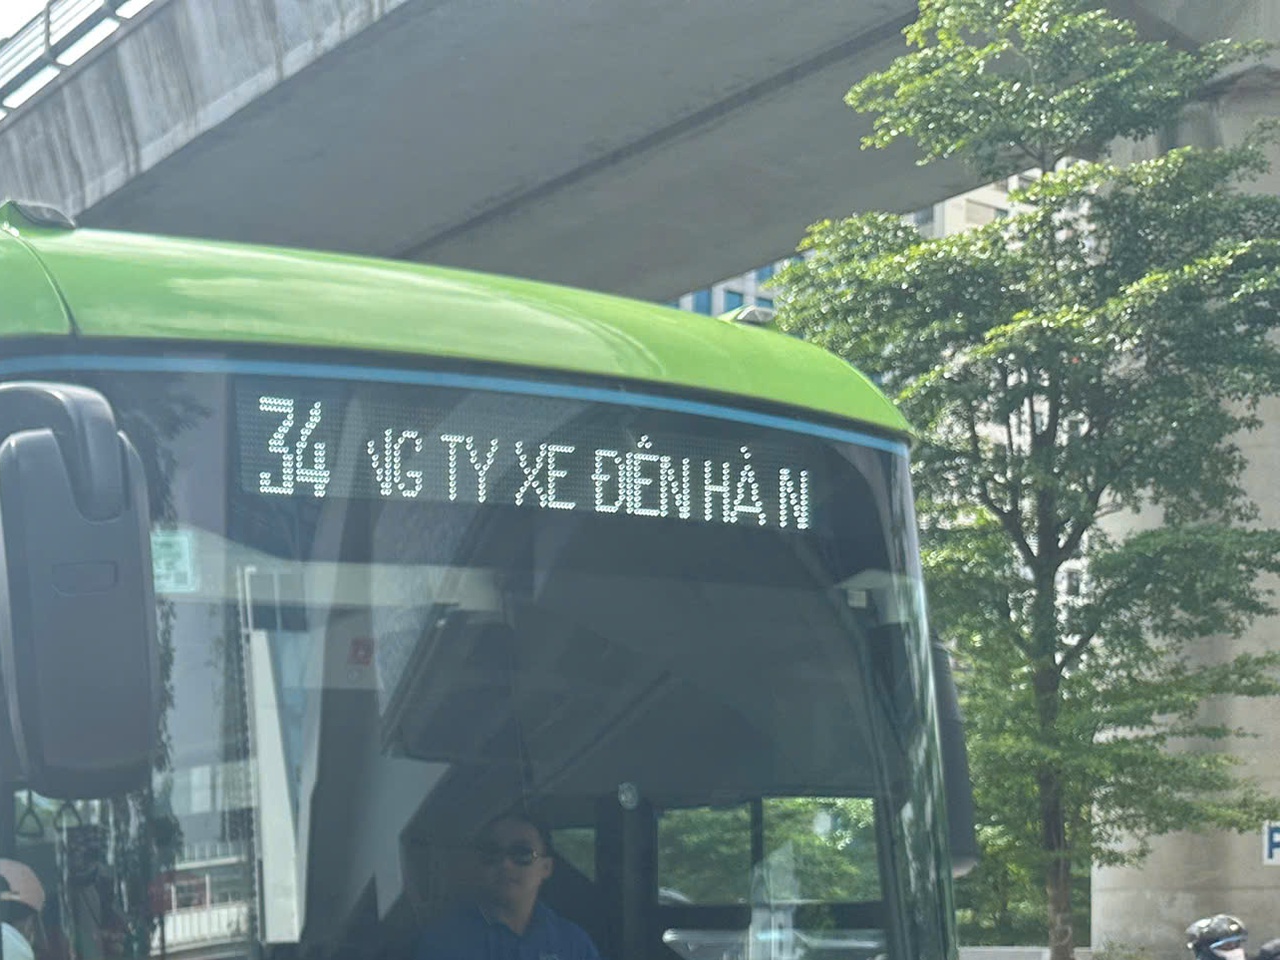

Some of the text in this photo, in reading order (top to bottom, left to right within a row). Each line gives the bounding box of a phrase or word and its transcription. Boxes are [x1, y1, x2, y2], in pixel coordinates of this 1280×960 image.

[259, 396, 330, 497] 34
[440, 433, 498, 503] TY
[515, 440, 575, 510] XE
